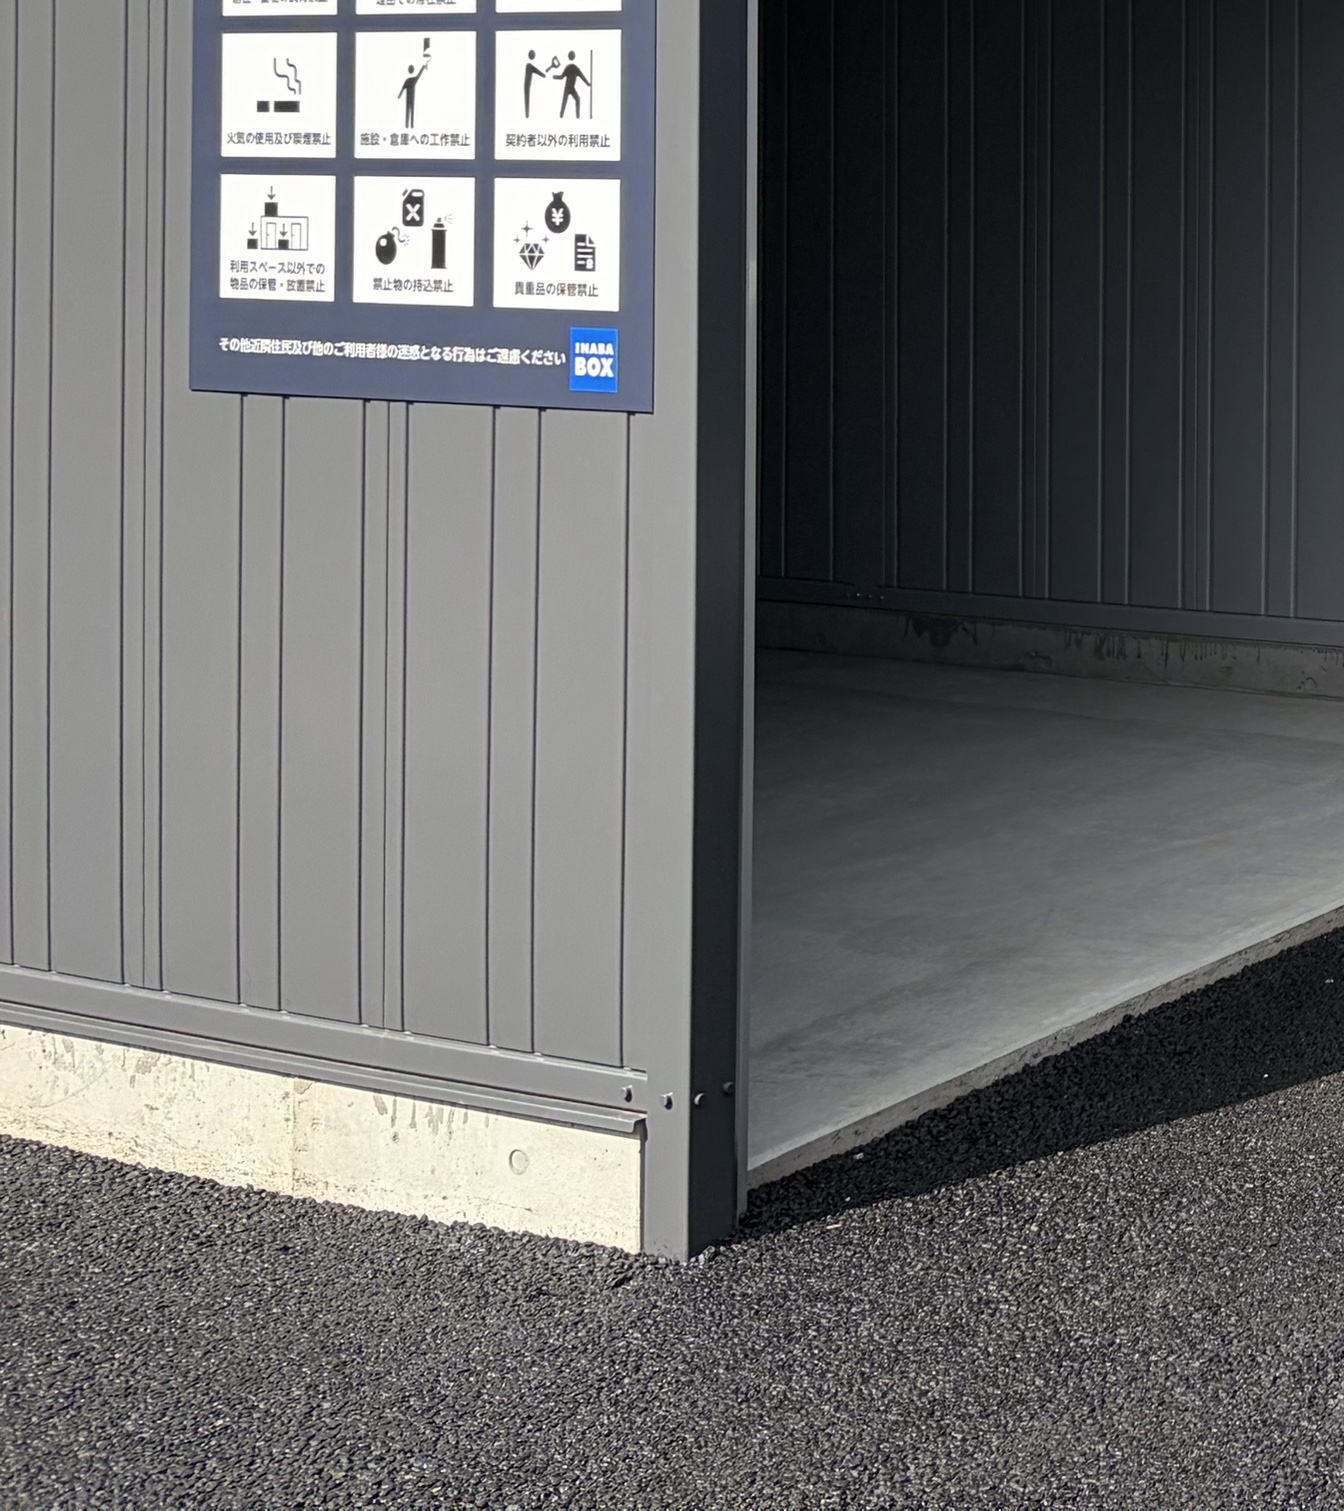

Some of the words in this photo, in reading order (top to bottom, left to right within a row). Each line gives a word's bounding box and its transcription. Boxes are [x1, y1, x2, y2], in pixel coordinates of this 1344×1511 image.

[505, 133, 611, 147] 契約者以外の利用禁止
[230, 259, 325, 275] 利用スペース以外での
[373, 277, 454, 292] 禁止物の持込禁止
[514, 281, 599, 297] 貴重品の保管禁止
[574, 342, 614, 356] INABA
[574, 356, 614, 377] BOX
